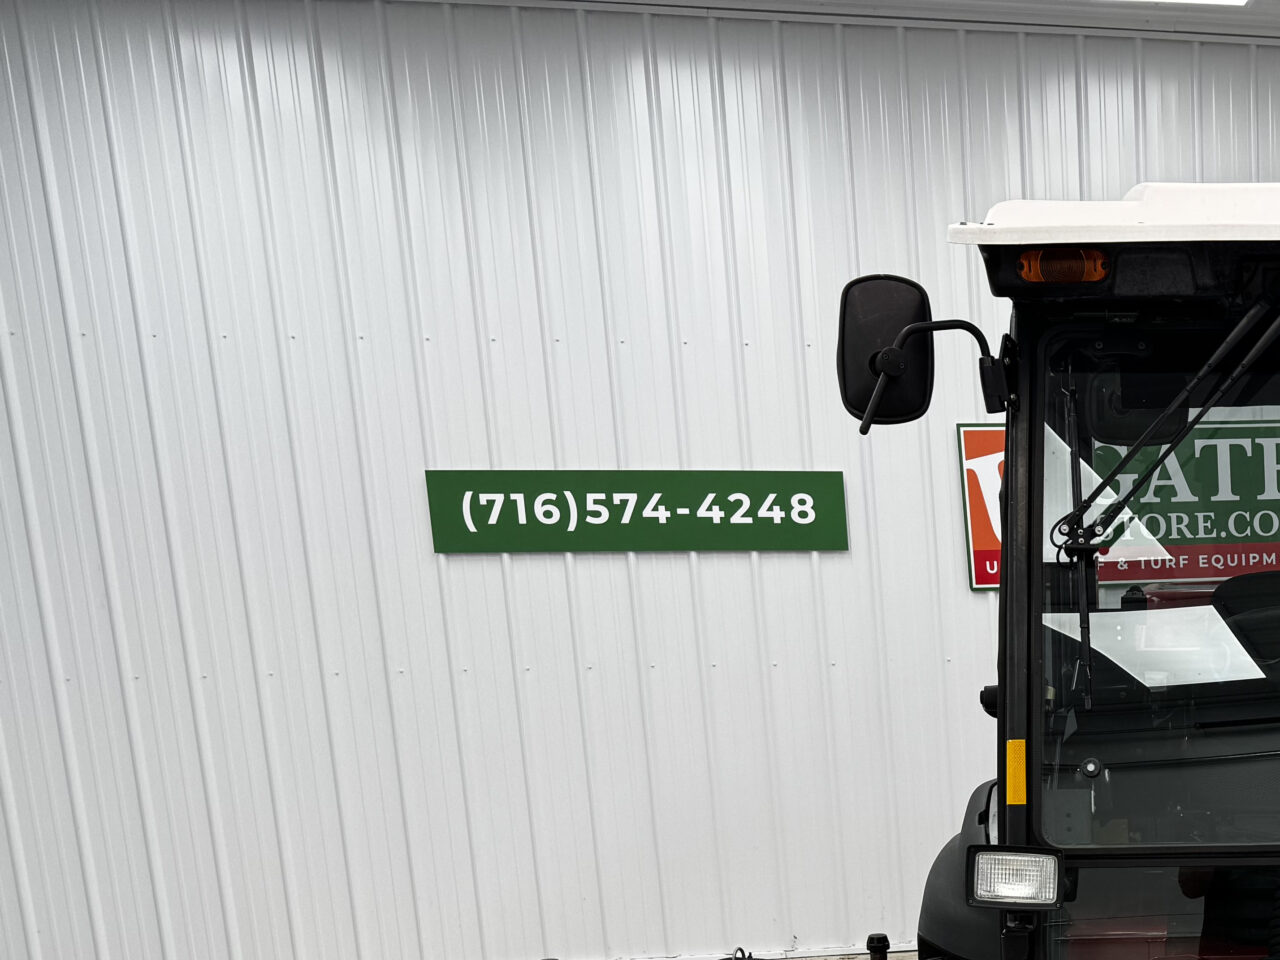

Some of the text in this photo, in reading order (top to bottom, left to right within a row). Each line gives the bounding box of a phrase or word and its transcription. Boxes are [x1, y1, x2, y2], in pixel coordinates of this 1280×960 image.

[461, 490, 816, 533] (716)574-4248
[1117, 557, 1129, 570] &
[1136, 555, 1189, 570] TURF
